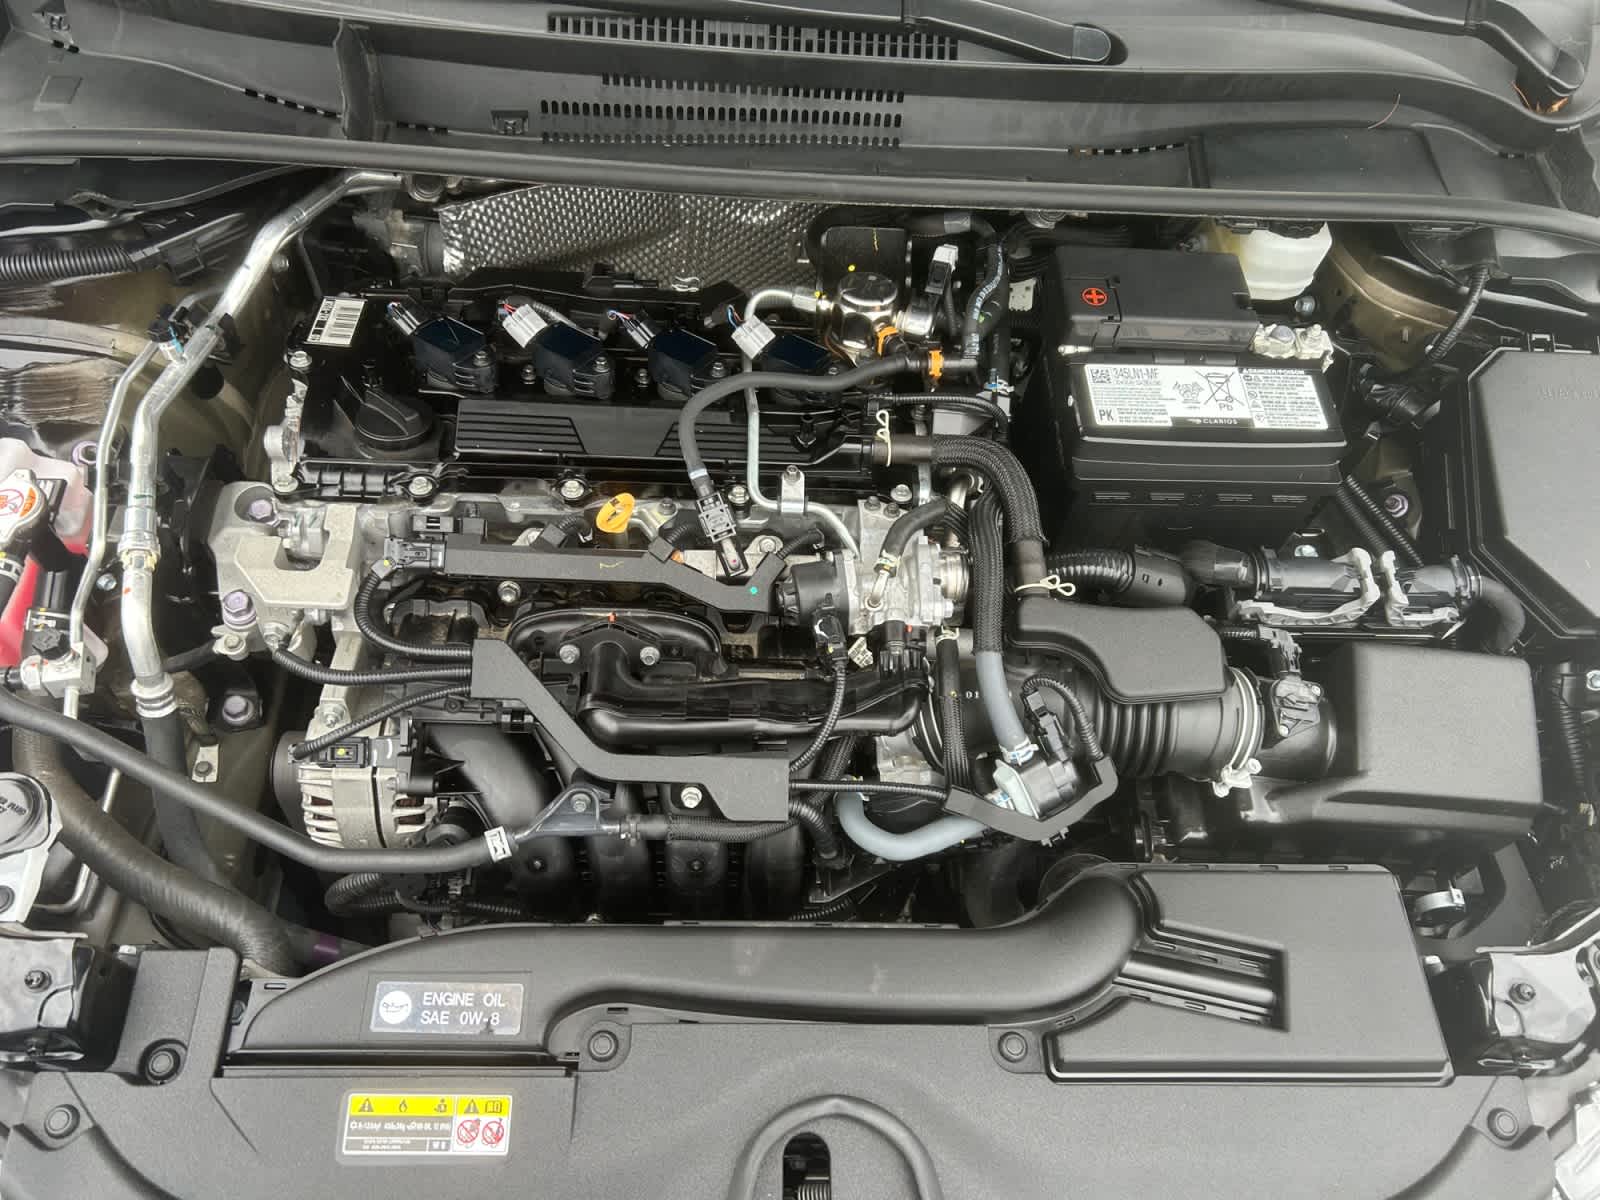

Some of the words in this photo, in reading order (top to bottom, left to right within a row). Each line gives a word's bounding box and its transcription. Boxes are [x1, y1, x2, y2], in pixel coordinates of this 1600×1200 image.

[1218, 402, 1234, 411] Pb
[1098, 409, 1114, 422] PK
[423, 991, 474, 1006] ENGINE
[483, 992, 505, 1007] OIL
[420, 1010, 450, 1025] SAE
[459, 1011, 501, 1026] 0W-8
